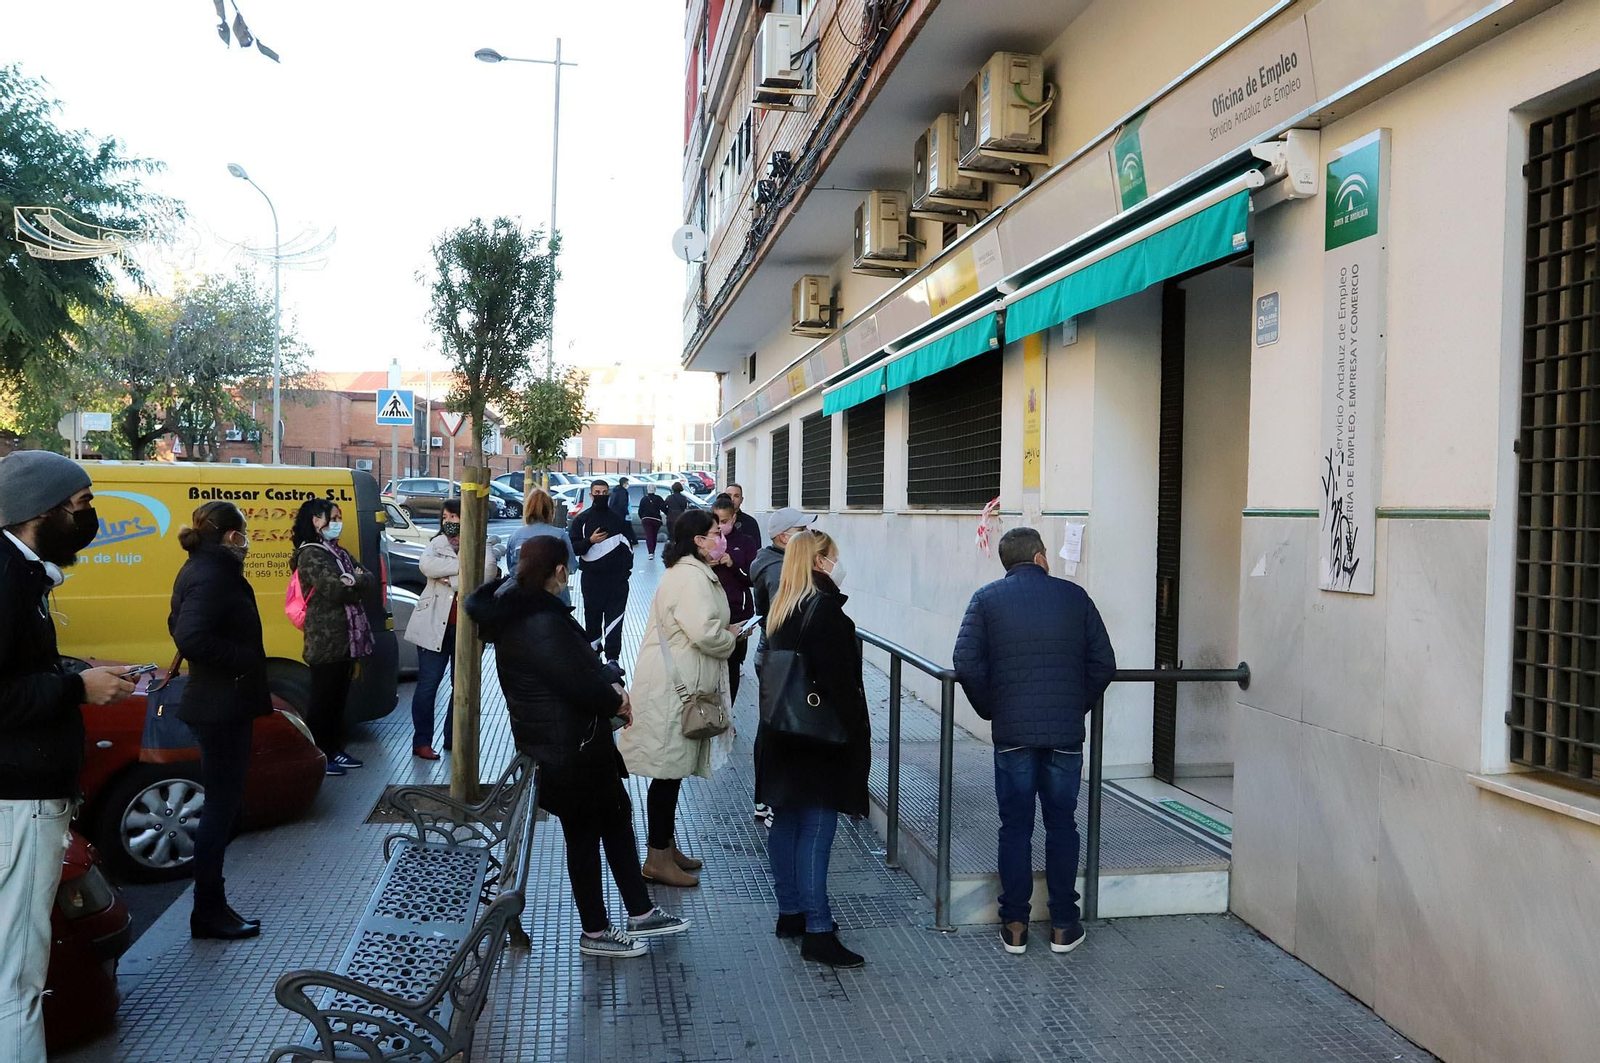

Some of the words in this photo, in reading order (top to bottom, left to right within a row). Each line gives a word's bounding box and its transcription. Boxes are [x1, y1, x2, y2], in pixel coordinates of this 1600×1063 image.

[1212, 86, 1245, 118] Oficina
[1245, 75, 1258, 98] de
[1258, 51, 1298, 89] Empleo
[1208, 118, 1233, 141] Servicio
[1234, 101, 1261, 127] Andaluz
[1262, 95, 1272, 109] de
[1273, 77, 1301, 102] Empleo
[1338, 267, 1349, 320] Empleo
[1350, 263, 1359, 334] COMERCIO
[1338, 323, 1346, 341] de
[1350, 337, 1357, 346] Y
[1336, 344, 1346, 401] Andaluz
[1348, 347, 1357, 408] EMPRESA
[1335, 404, 1345, 457] Servicio
[1347, 411, 1357, 467] EMPLEO,
[188, 486, 260, 500] Baltasar
[325, 489, 353, 502] S.L.
[1346, 469, 1354, 488] DE
[93, 553, 111, 563] de
[115, 552, 143, 566] lujo
[245, 551, 292, 559] Circunvalac
[267, 560, 289, 569] Baja)
[255, 570, 271, 578] 959
[274, 570, 284, 578] 15
